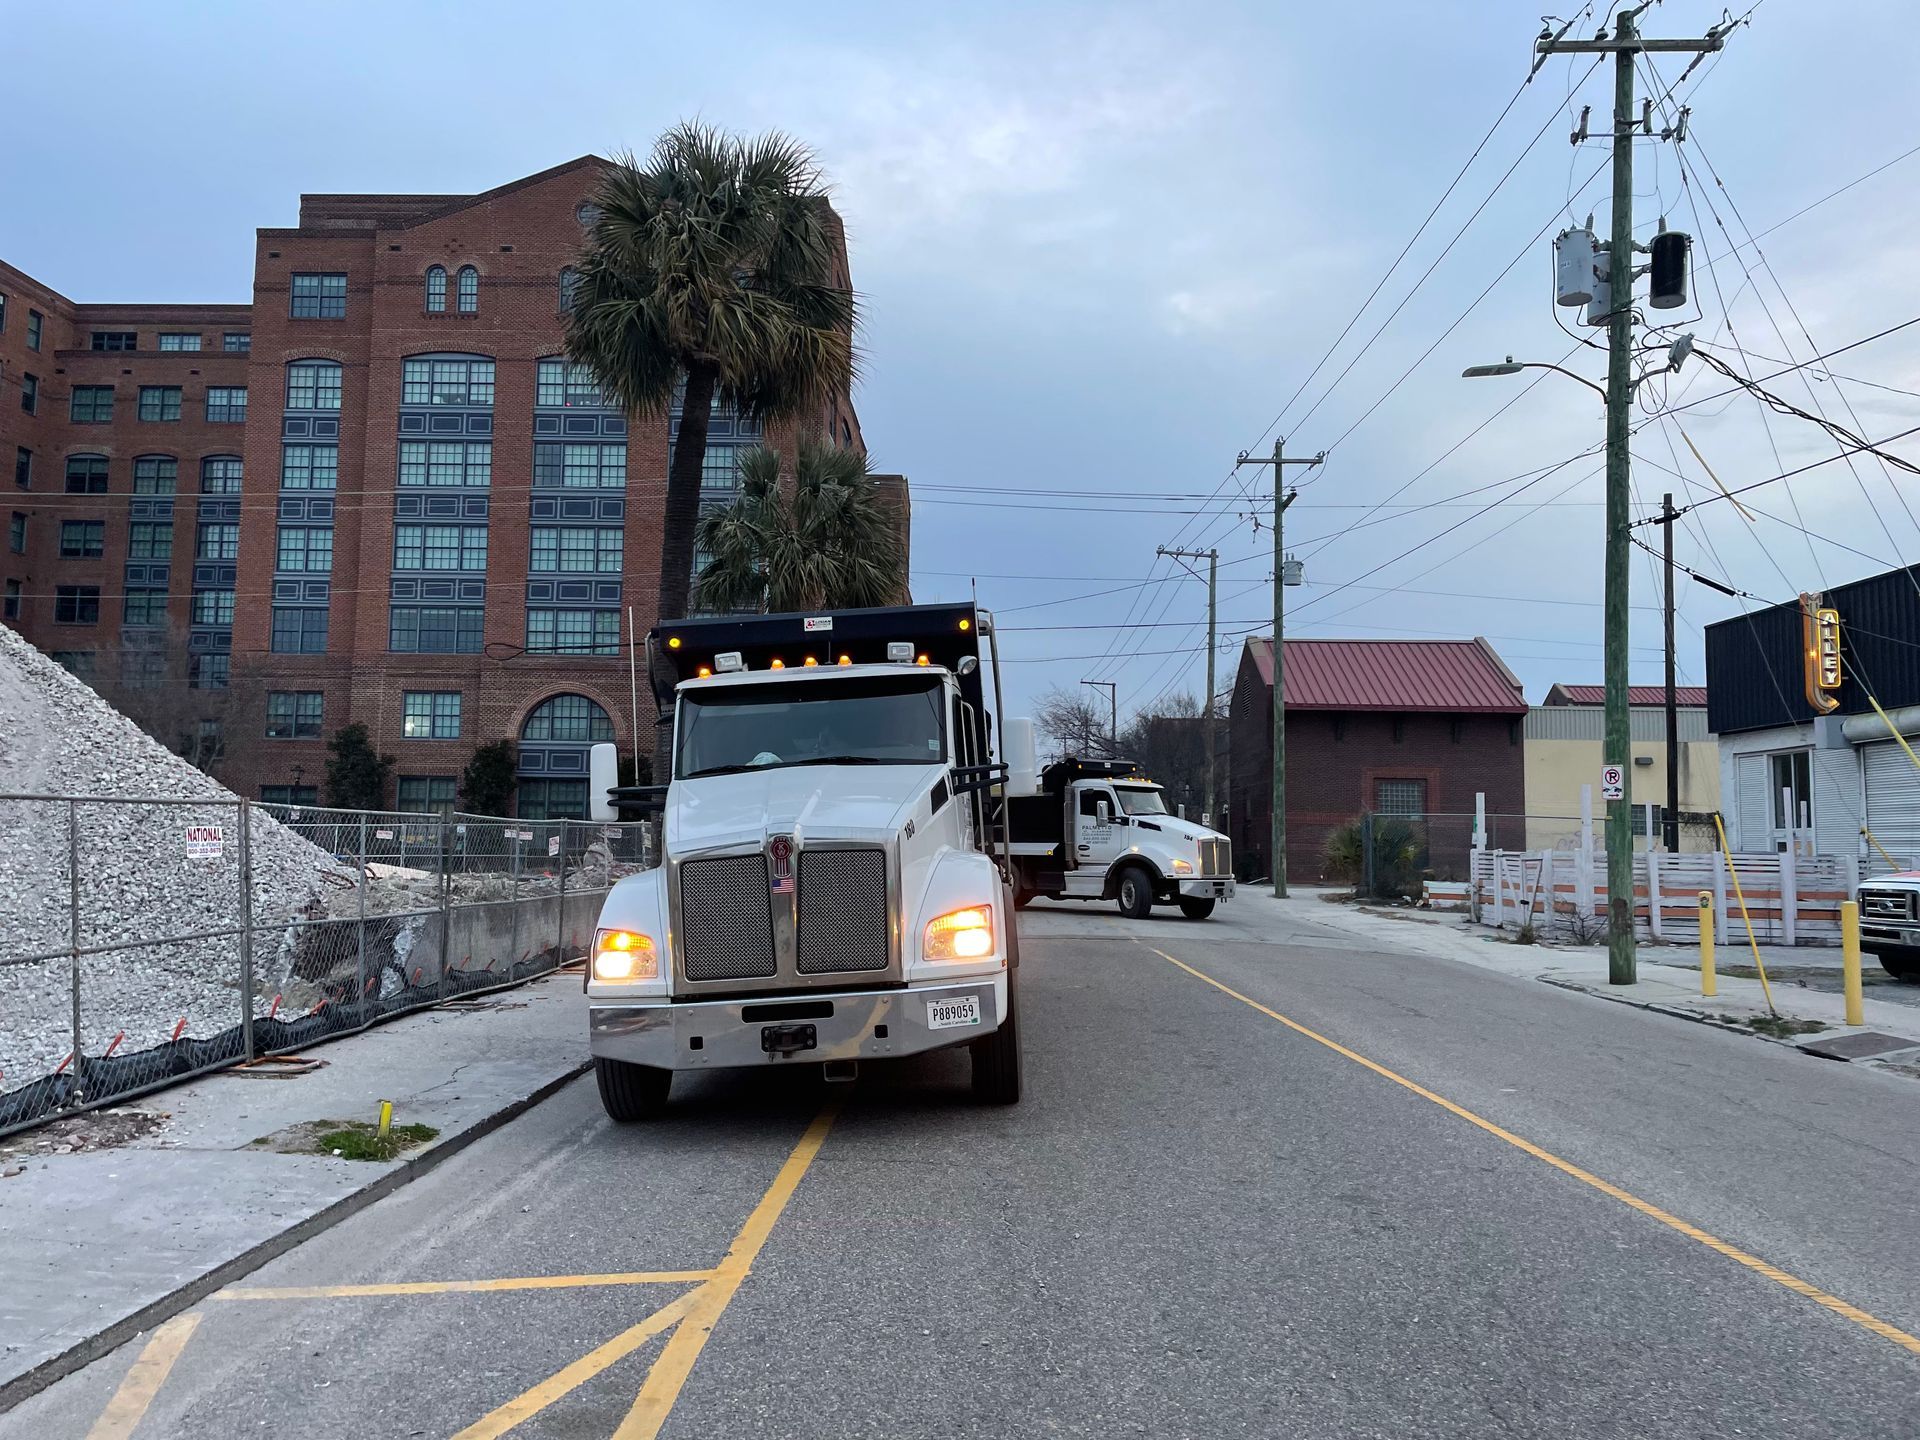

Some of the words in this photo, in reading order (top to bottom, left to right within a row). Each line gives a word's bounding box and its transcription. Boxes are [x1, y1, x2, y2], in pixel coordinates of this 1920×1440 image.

[1821, 613, 1838, 684] ALLEY
[187, 827, 221, 842] NATIONAL
[904, 819, 915, 840] 180
[933, 1005, 974, 1021] P889059
